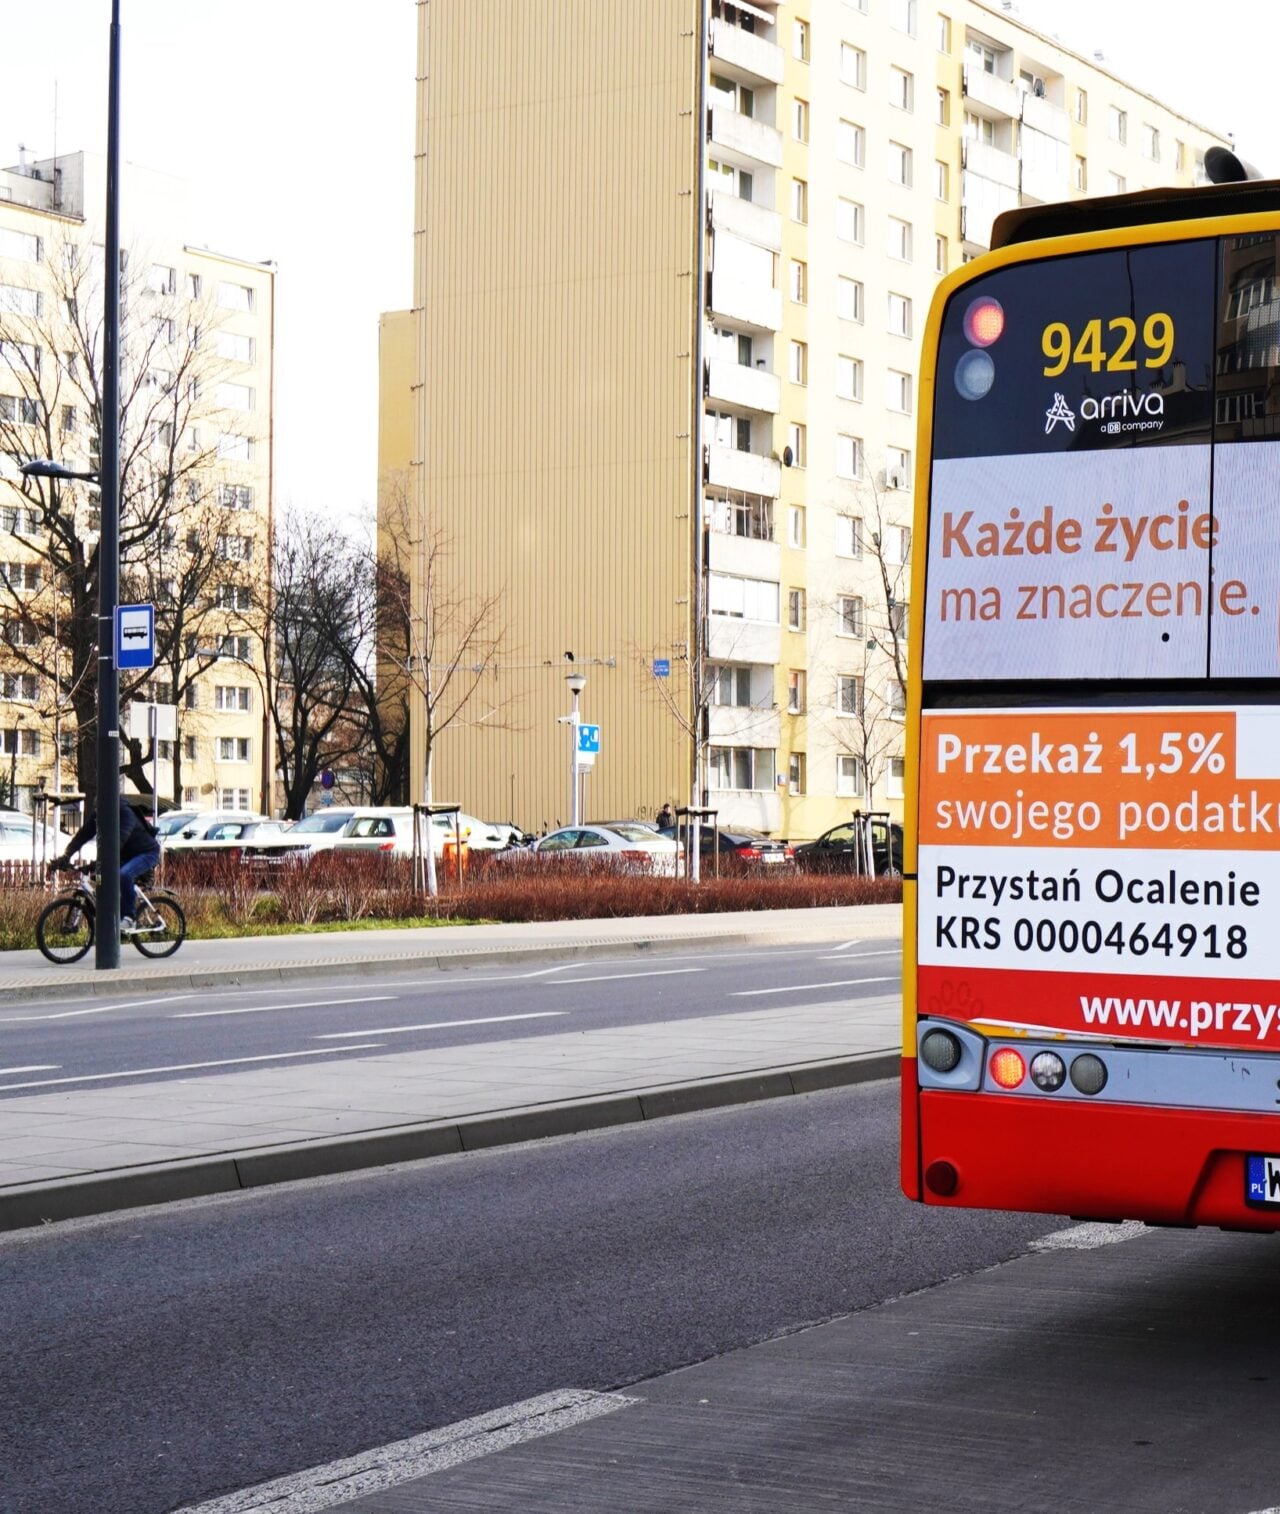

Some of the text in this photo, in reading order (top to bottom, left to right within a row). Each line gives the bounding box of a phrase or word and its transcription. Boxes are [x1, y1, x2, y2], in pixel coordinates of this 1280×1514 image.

[1041, 312, 1175, 377] 9429
[1080, 388, 1164, 420] arriva
[1100, 420, 1164, 434] a DB company
[942, 499, 1221, 562] Każde życie
[939, 585, 1003, 622] ma
[936, 731, 1227, 782] Przekaż 1,5%
[936, 790, 1101, 838] swojego
[935, 865, 1261, 907] Przystań Ocalenie
[935, 916, 1248, 960] KRS 0000464918
[1251, 1182, 1264, 1194] PL
